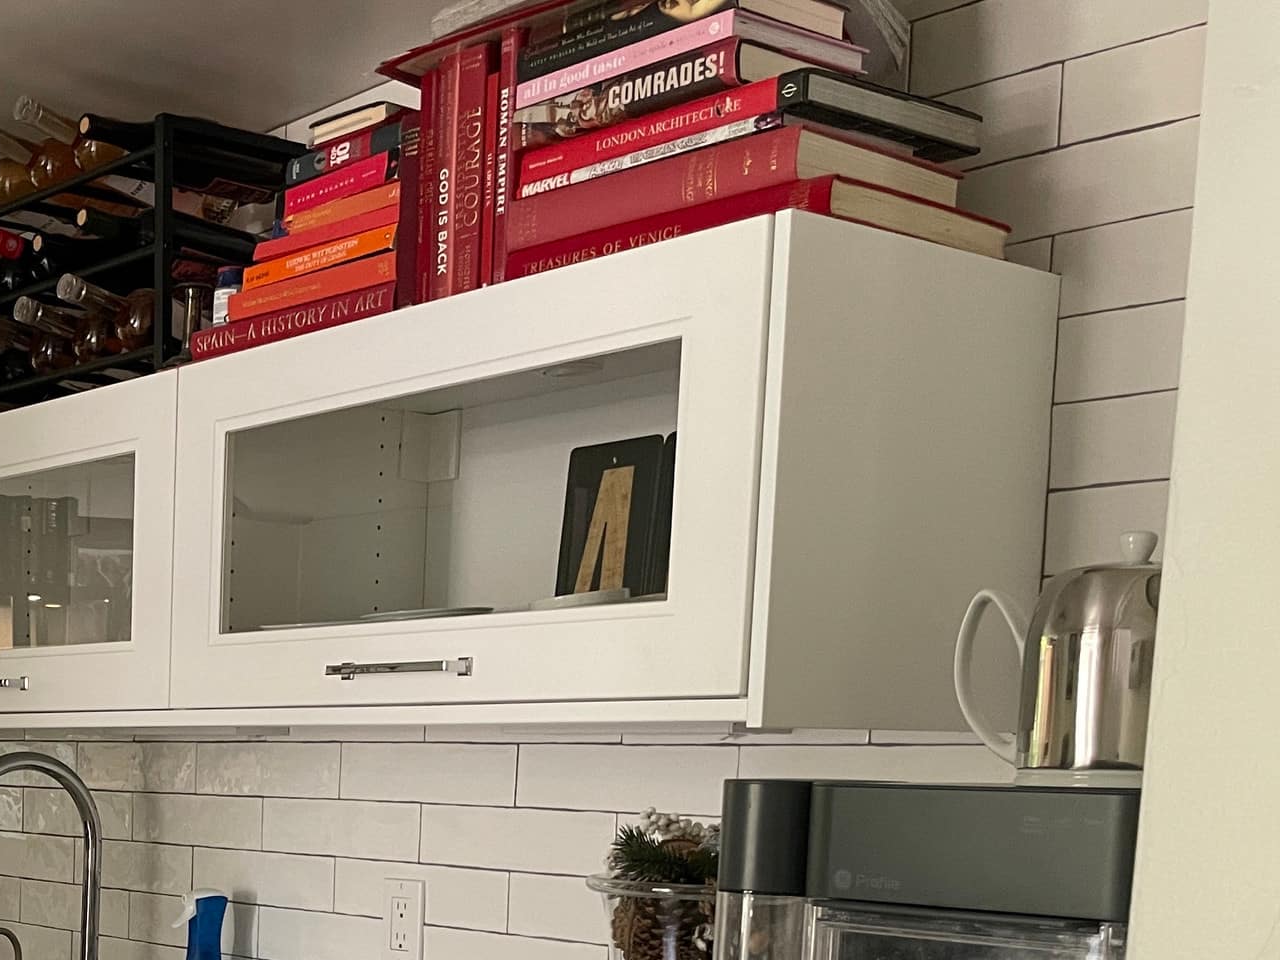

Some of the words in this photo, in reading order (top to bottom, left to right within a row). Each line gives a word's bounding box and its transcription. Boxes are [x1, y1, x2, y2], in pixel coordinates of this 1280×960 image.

[523, 82, 540, 99] all
[544, 79, 557, 91] in
[559, 65, 589, 91] good
[592, 55, 625, 75] taste
[608, 51, 725, 110] COMRADES!
[499, 88, 509, 147] ROMAN
[595, 123, 647, 152] LONDON
[648, 97, 742, 136] ARCHITECTURE
[335, 142, 351, 165] 10
[463, 106, 482, 227] COURAGE
[439, 168, 449, 205] GOD
[495, 154, 507, 216] EMPIRE
[522, 172, 570, 199] MARVEL
[438, 210, 448, 226] IS
[436, 230, 448, 276] BACK
[523, 246, 597, 274] TREASURES
[602, 239, 621, 257] OF
[628, 225, 683, 247] VENICE
[261, 304, 326, 338] HISTORY
[331, 301, 350, 320] IN
[354, 289, 388, 313] ART
